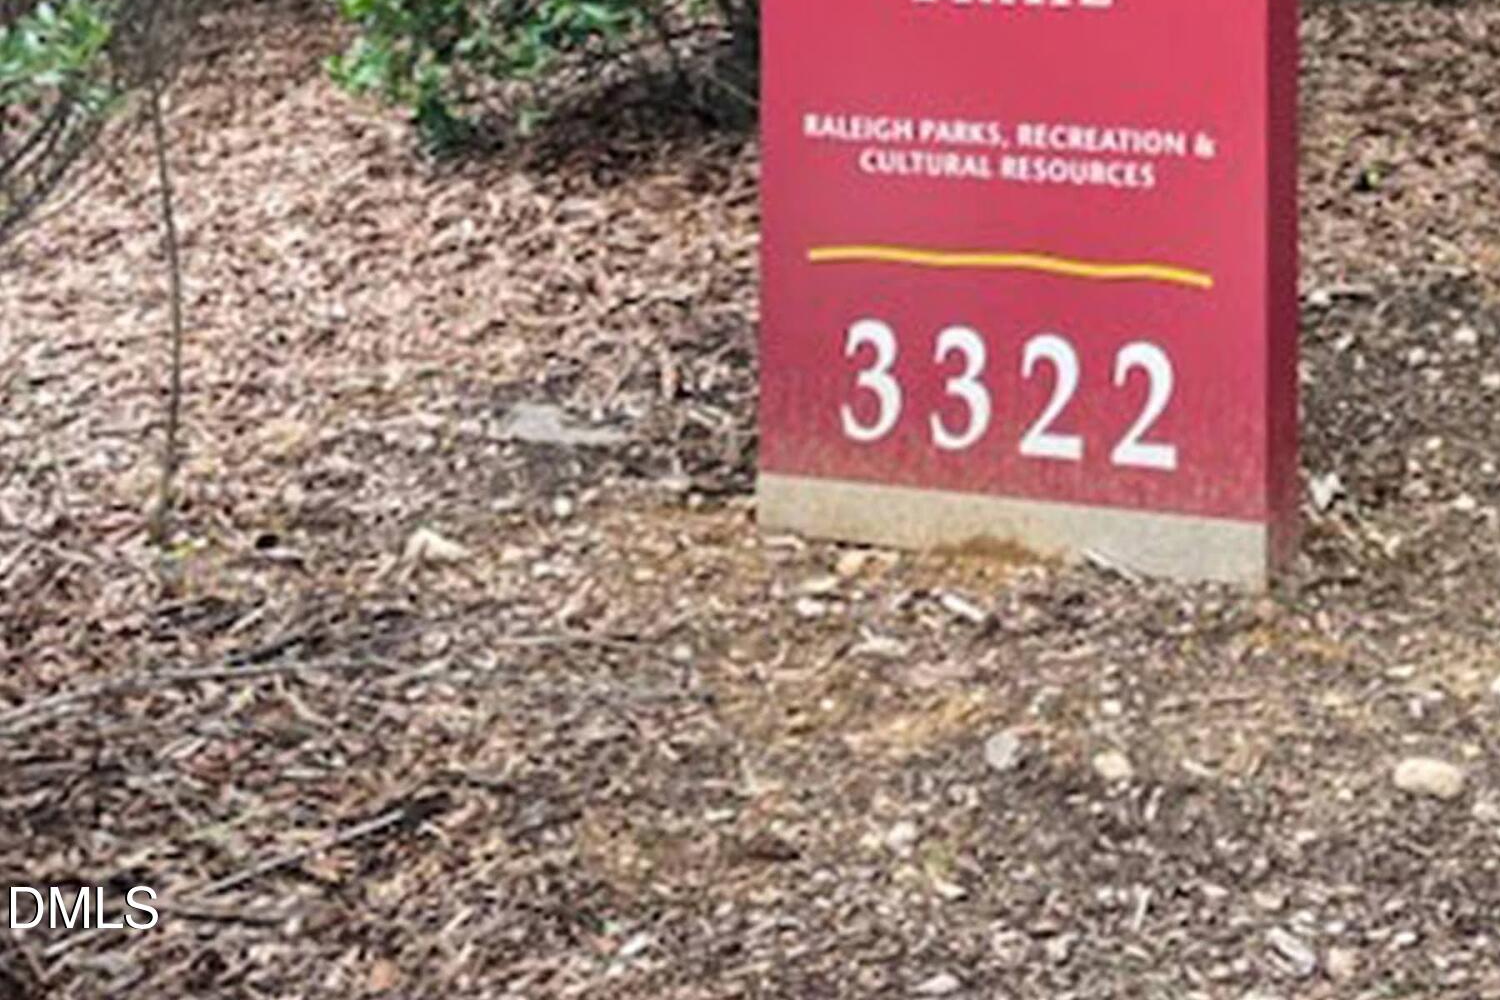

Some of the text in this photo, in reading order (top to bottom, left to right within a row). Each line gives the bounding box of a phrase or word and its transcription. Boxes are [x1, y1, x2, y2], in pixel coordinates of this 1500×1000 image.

[803, 113, 1215, 159] RALEIGH PARKS, RECREATION &
[859, 147, 1156, 188] CULTURAL RESOURCES
[840, 318, 1177, 470] 3322
